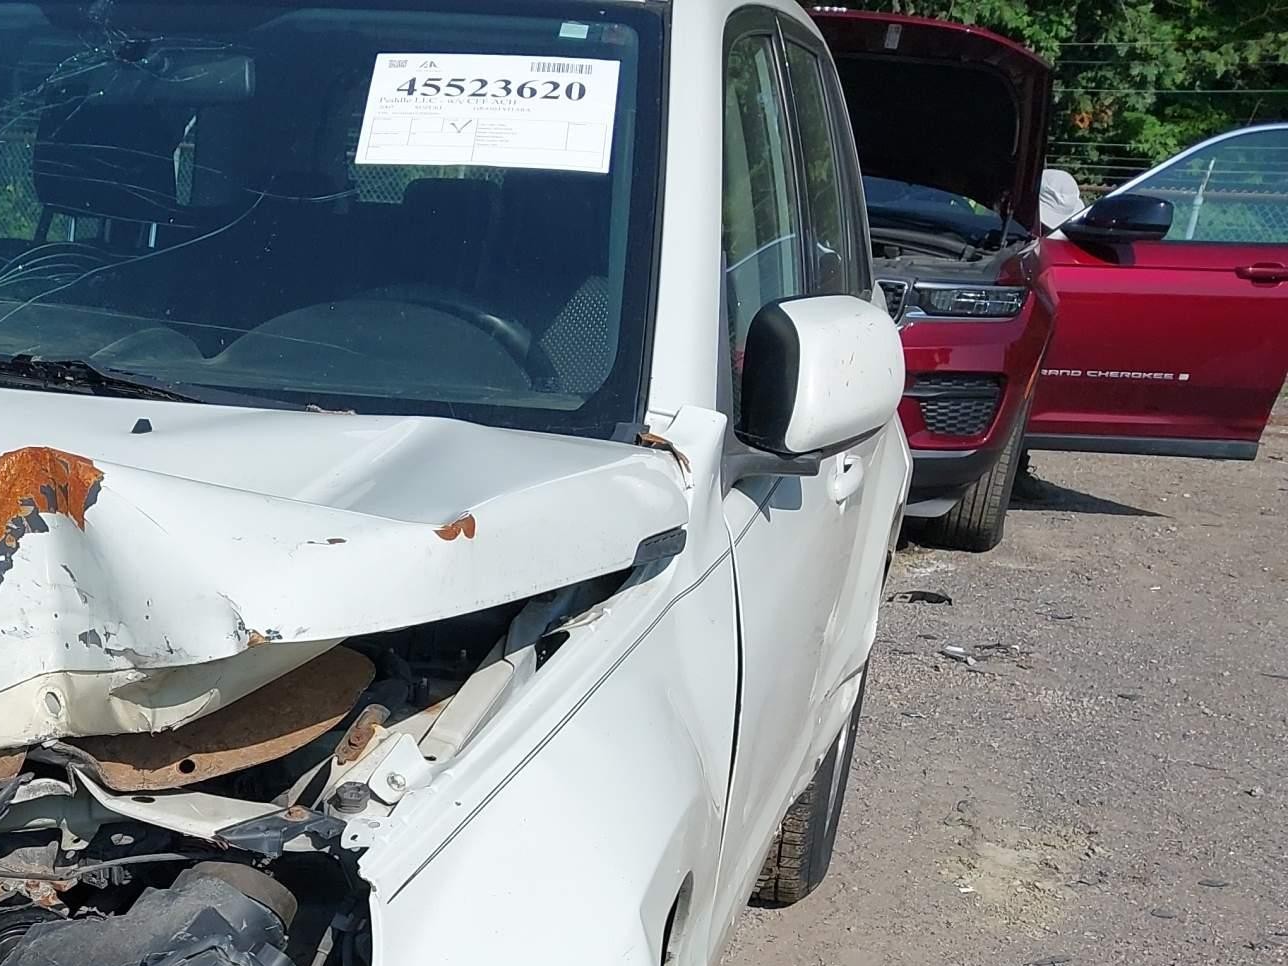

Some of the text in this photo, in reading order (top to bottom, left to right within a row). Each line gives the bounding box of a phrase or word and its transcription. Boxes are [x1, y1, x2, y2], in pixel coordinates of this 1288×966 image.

[396, 76, 587, 102] 45523620
[1040, 368, 1174, 380] RAND CHEROKEE
